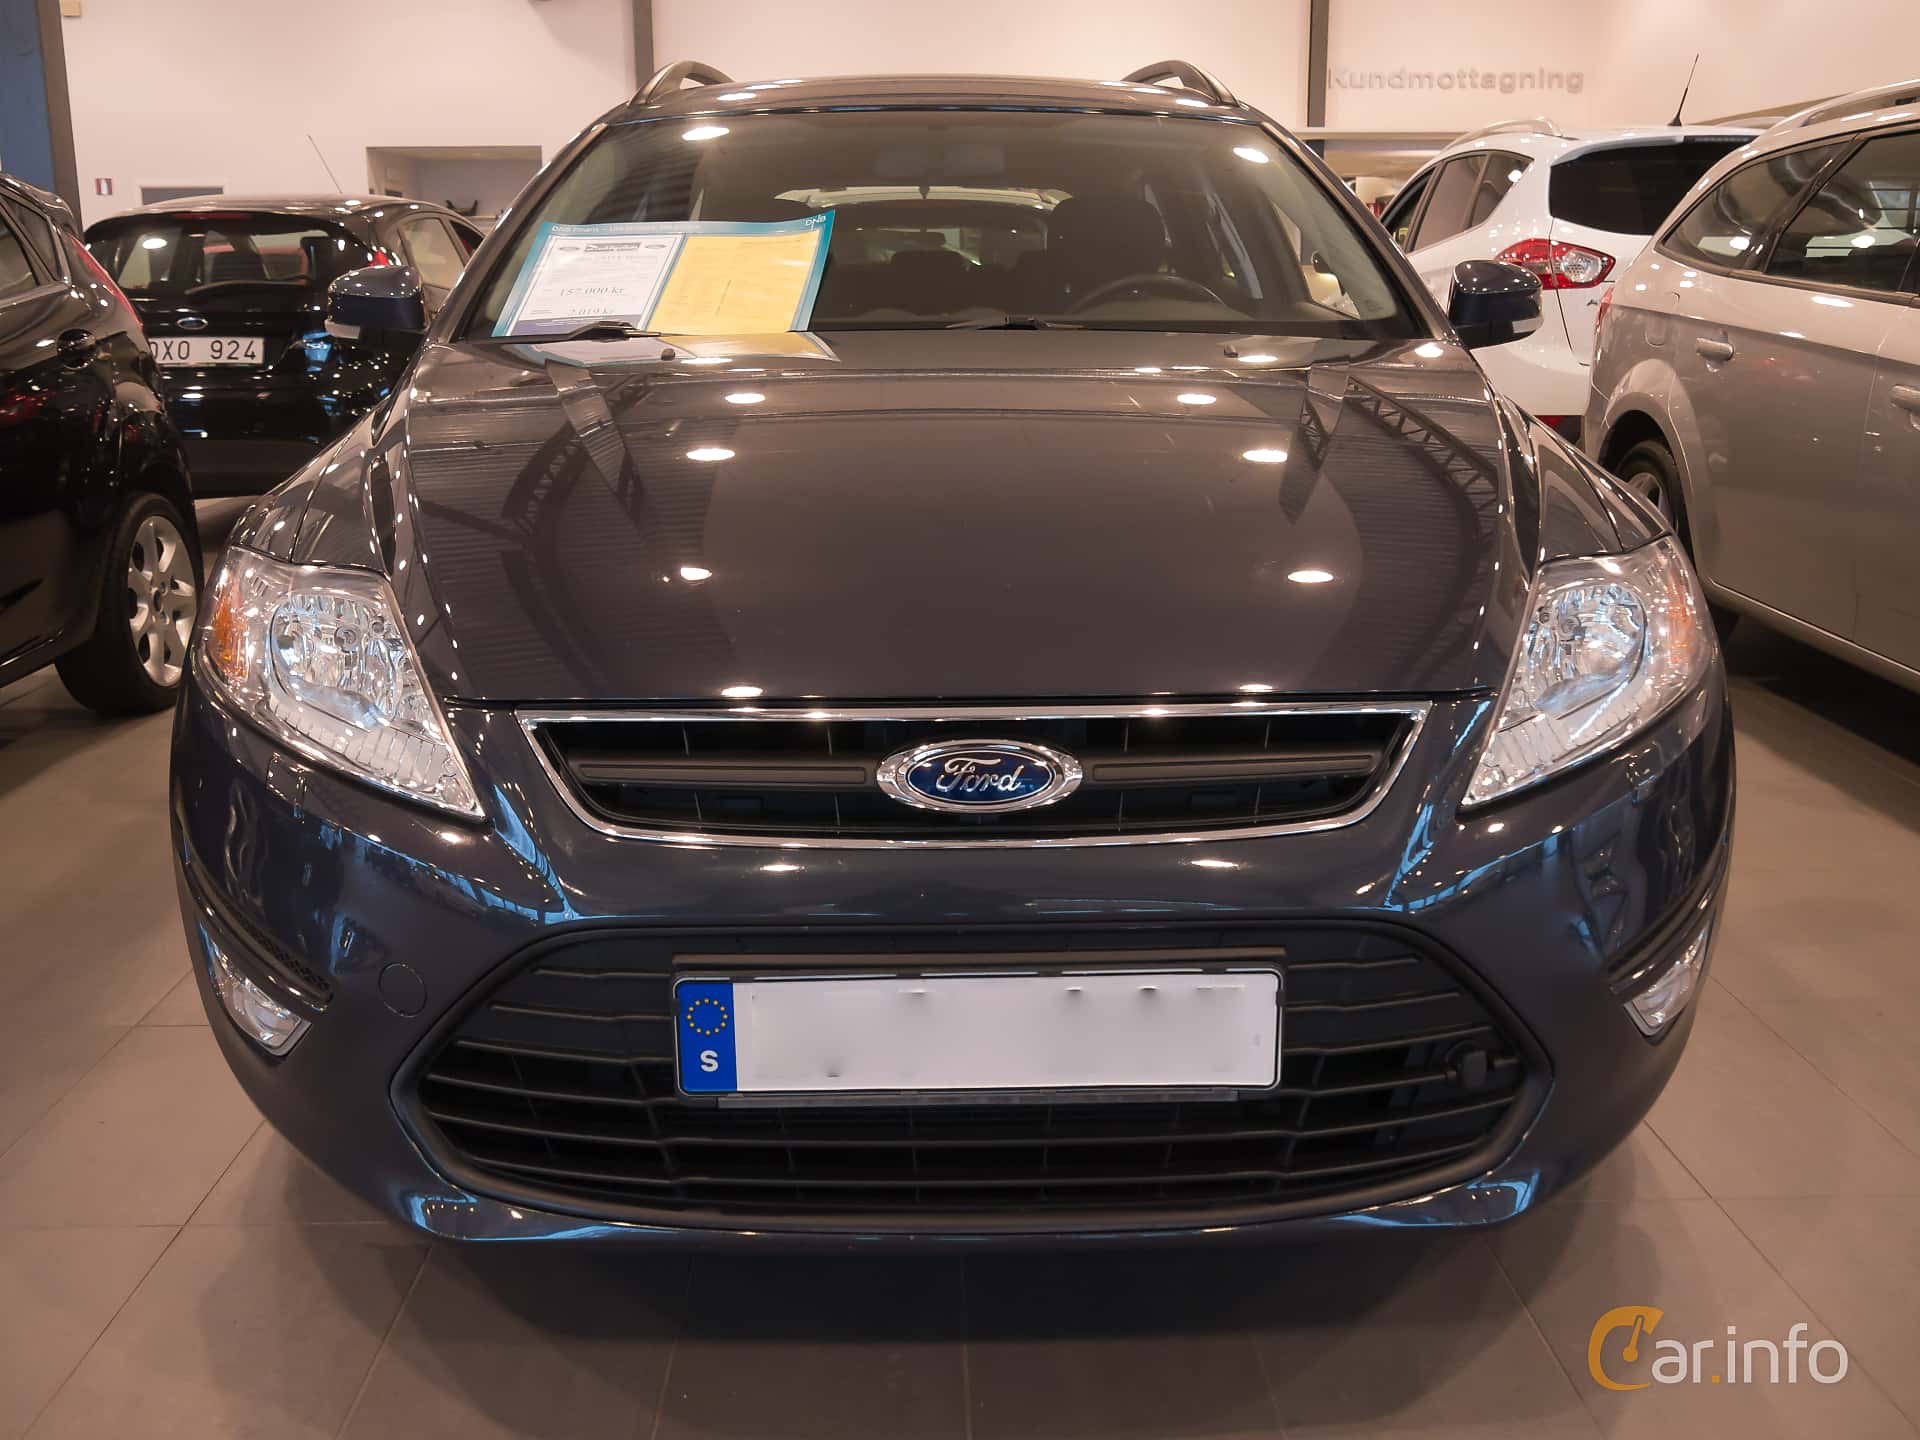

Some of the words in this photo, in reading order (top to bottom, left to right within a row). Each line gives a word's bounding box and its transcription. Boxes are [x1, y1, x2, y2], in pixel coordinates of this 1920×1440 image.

[1327, 67, 1585, 94] Kundmottagning
[209, 340, 257, 360] 924
[935, 757, 1025, 792] Ford
[700, 1049, 719, 1073] S
